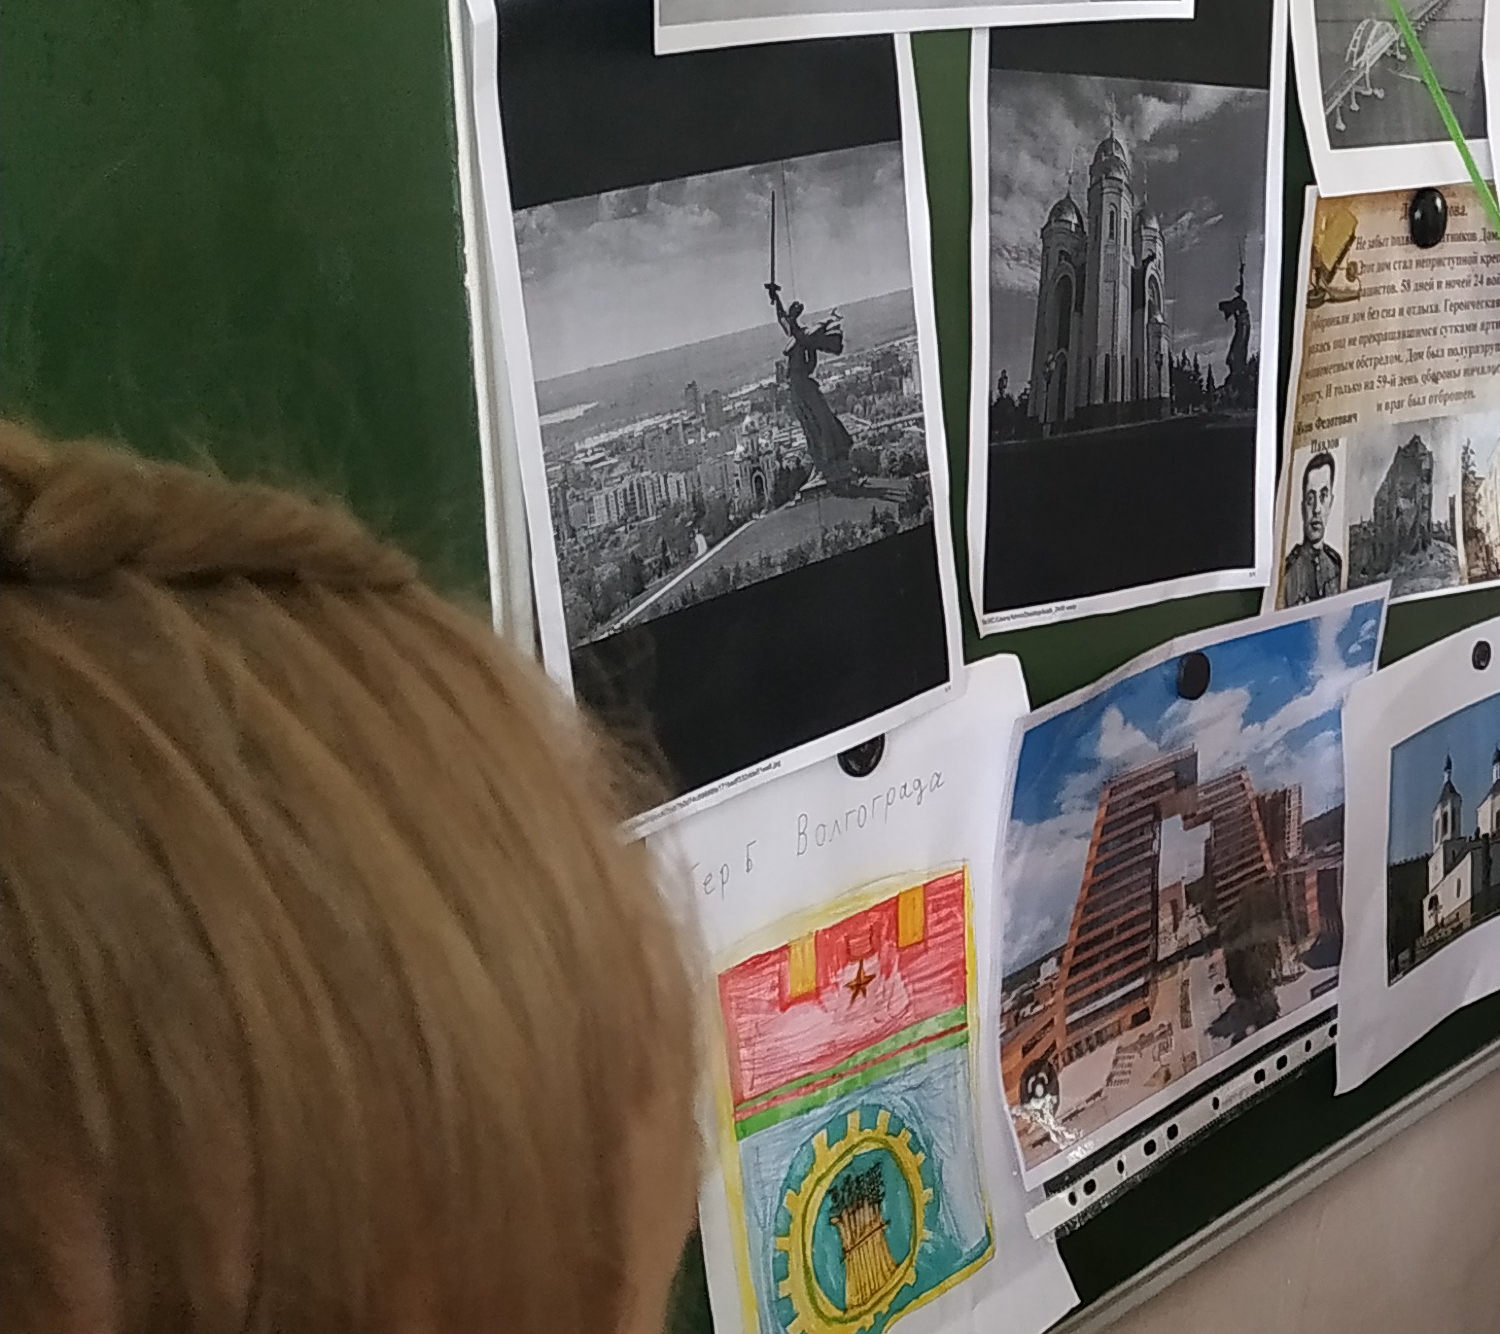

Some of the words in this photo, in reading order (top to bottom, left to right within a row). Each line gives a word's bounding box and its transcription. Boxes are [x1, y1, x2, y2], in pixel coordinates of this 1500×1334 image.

[1393, 259, 1413, 272] стал
[1415, 250, 1478, 271] неприступной
[1413, 277, 1434, 292] дней
[1445, 275, 1471, 289] ночей
[1473, 273, 1485, 287] 24
[1444, 298, 1500, 315] Героическая
[1440, 322, 1477, 338] сутками
[1405, 347, 1424, 363] Дом
[1426, 345, 1445, 360] был
[1334, 381, 1362, 396] только
[1364, 379, 1374, 391] на
[1399, 373, 1419, 387] день
[1385, 398, 1405, 414] враг
[1407, 393, 1427, 408] был
[796, 770, 945, 857] Волгограда
